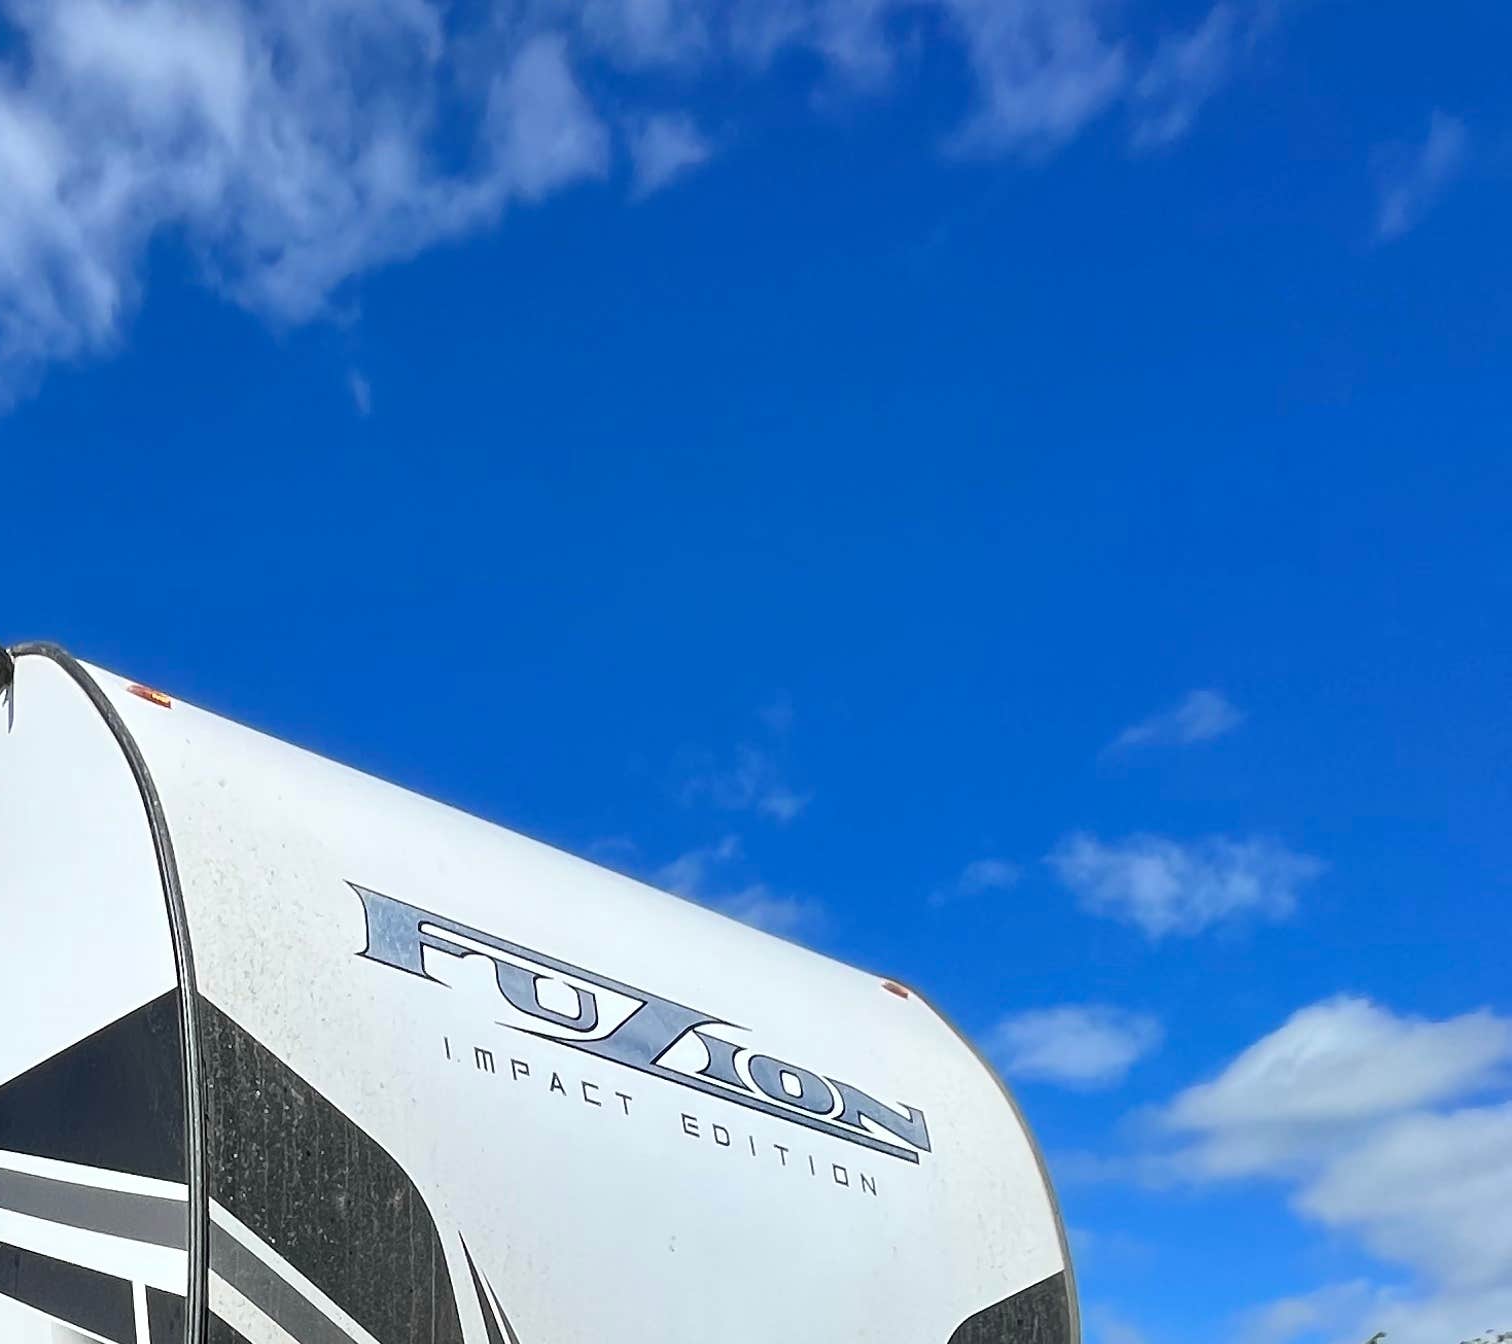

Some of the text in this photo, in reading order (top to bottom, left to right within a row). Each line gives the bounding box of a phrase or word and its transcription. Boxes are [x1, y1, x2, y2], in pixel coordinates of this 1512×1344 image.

[344, 879, 931, 1164] FUZION
[442, 1035, 878, 1197] IMPACT EDITION
